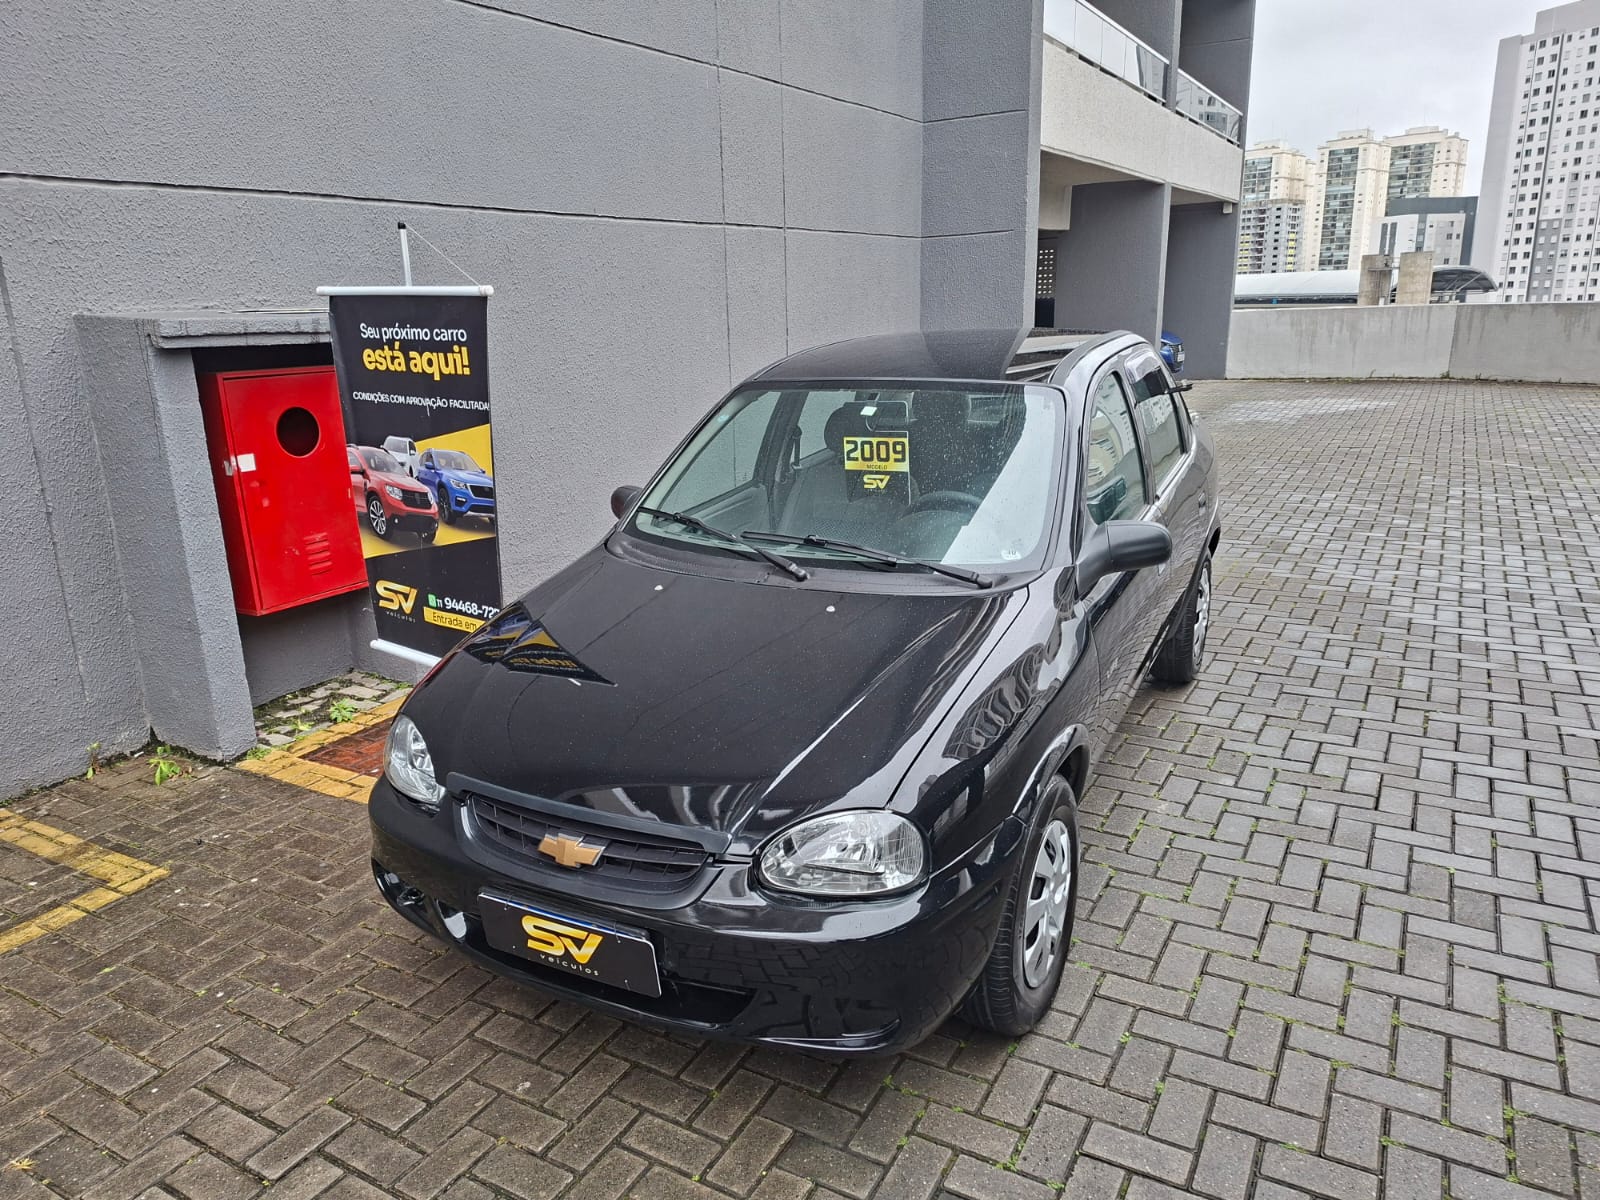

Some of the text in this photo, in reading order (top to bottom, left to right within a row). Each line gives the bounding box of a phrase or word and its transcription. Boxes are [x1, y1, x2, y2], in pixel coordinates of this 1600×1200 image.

[360, 322, 467, 342] Seu próximo carro
[362, 342, 471, 381] está aqui!
[352, 391, 389, 404] CONDIÇÕES
[389, 395, 405, 405] COM
[405, 396, 448, 409] APROVAÇÃO
[844, 440, 906, 462] 2009
[863, 474, 890, 489] SV
[375, 580, 418, 614] SV
[432, 612, 477, 631] Entrada em
[521, 914, 604, 964] SV
[539, 954, 599, 976] veiculos
